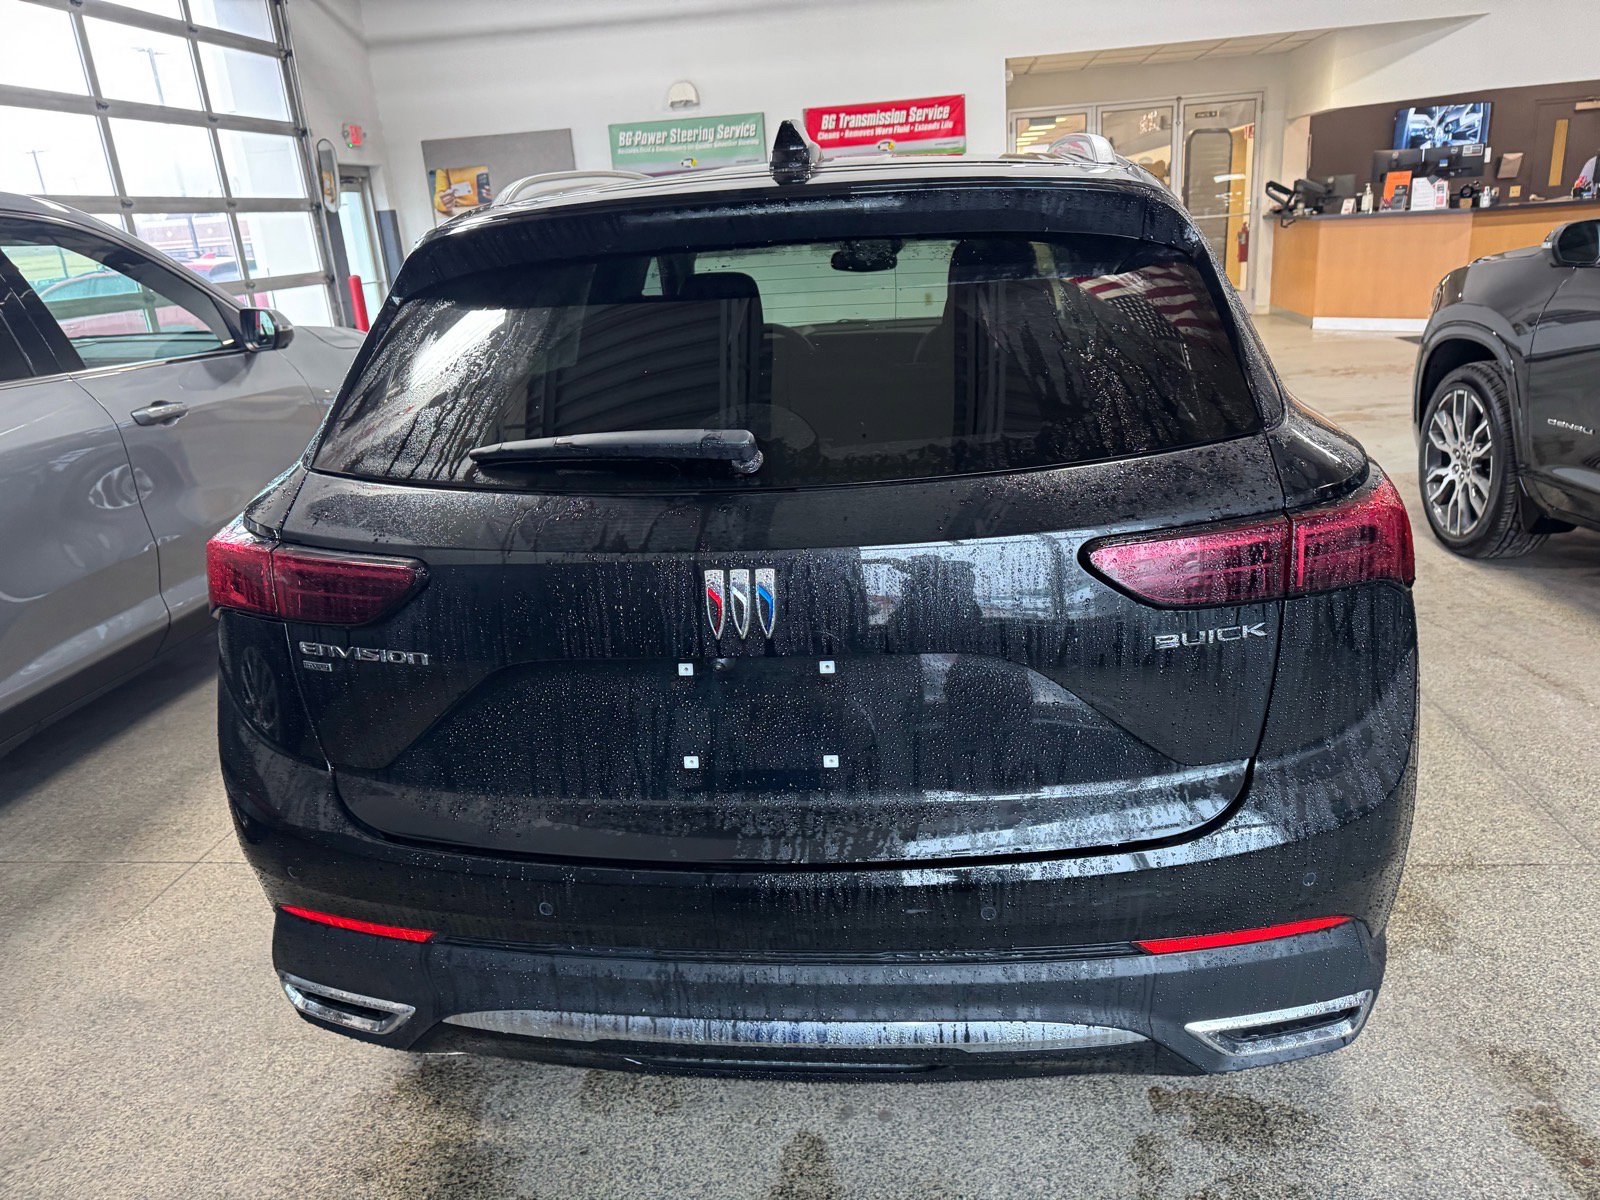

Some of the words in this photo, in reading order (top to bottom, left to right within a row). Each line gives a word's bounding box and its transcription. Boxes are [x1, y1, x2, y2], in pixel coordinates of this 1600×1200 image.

[821, 113, 836, 130] BG
[838, 108, 907, 129] Transmission
[908, 105, 951, 122] Service
[618, 131, 632, 147] BG
[633, 130, 667, 146] Power
[669, 126, 714, 144] Steering
[716, 122, 756, 139] Service
[844, 128, 874, 138] Removes
[893, 125, 910, 134] Fluid
[1154, 622, 1268, 650] BUICK
[299, 641, 429, 666] ENVISION
